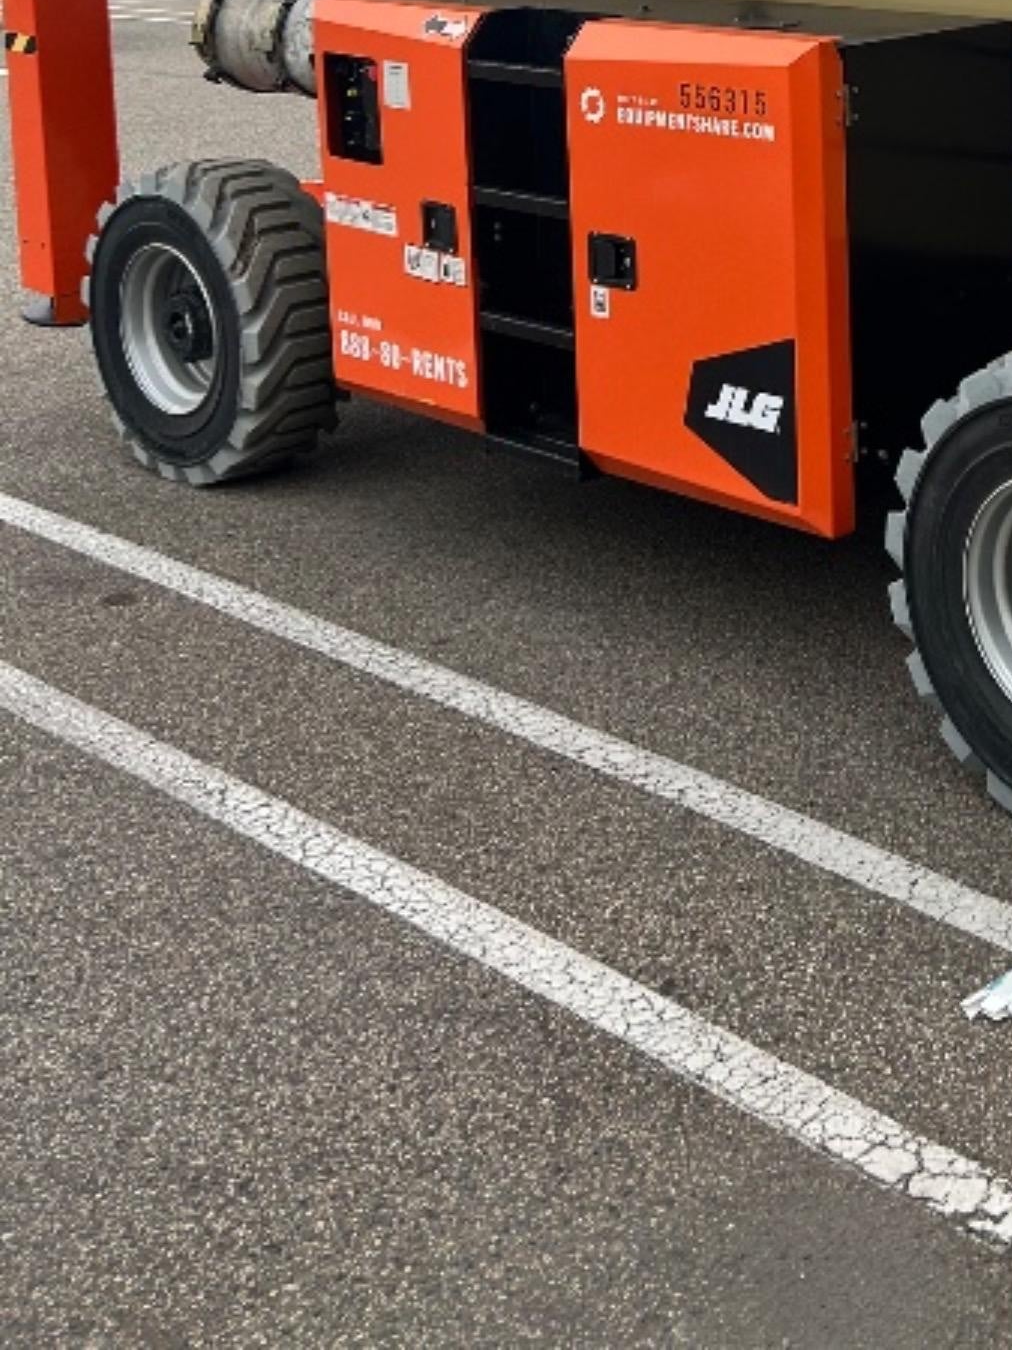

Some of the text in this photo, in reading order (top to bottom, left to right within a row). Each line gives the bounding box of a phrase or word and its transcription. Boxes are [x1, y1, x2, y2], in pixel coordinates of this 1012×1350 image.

[679, 83, 766, 116] 556315
[616, 106, 775, 141] EQUIPMENTSHARE.COM
[704, 383, 784, 433] JLG
